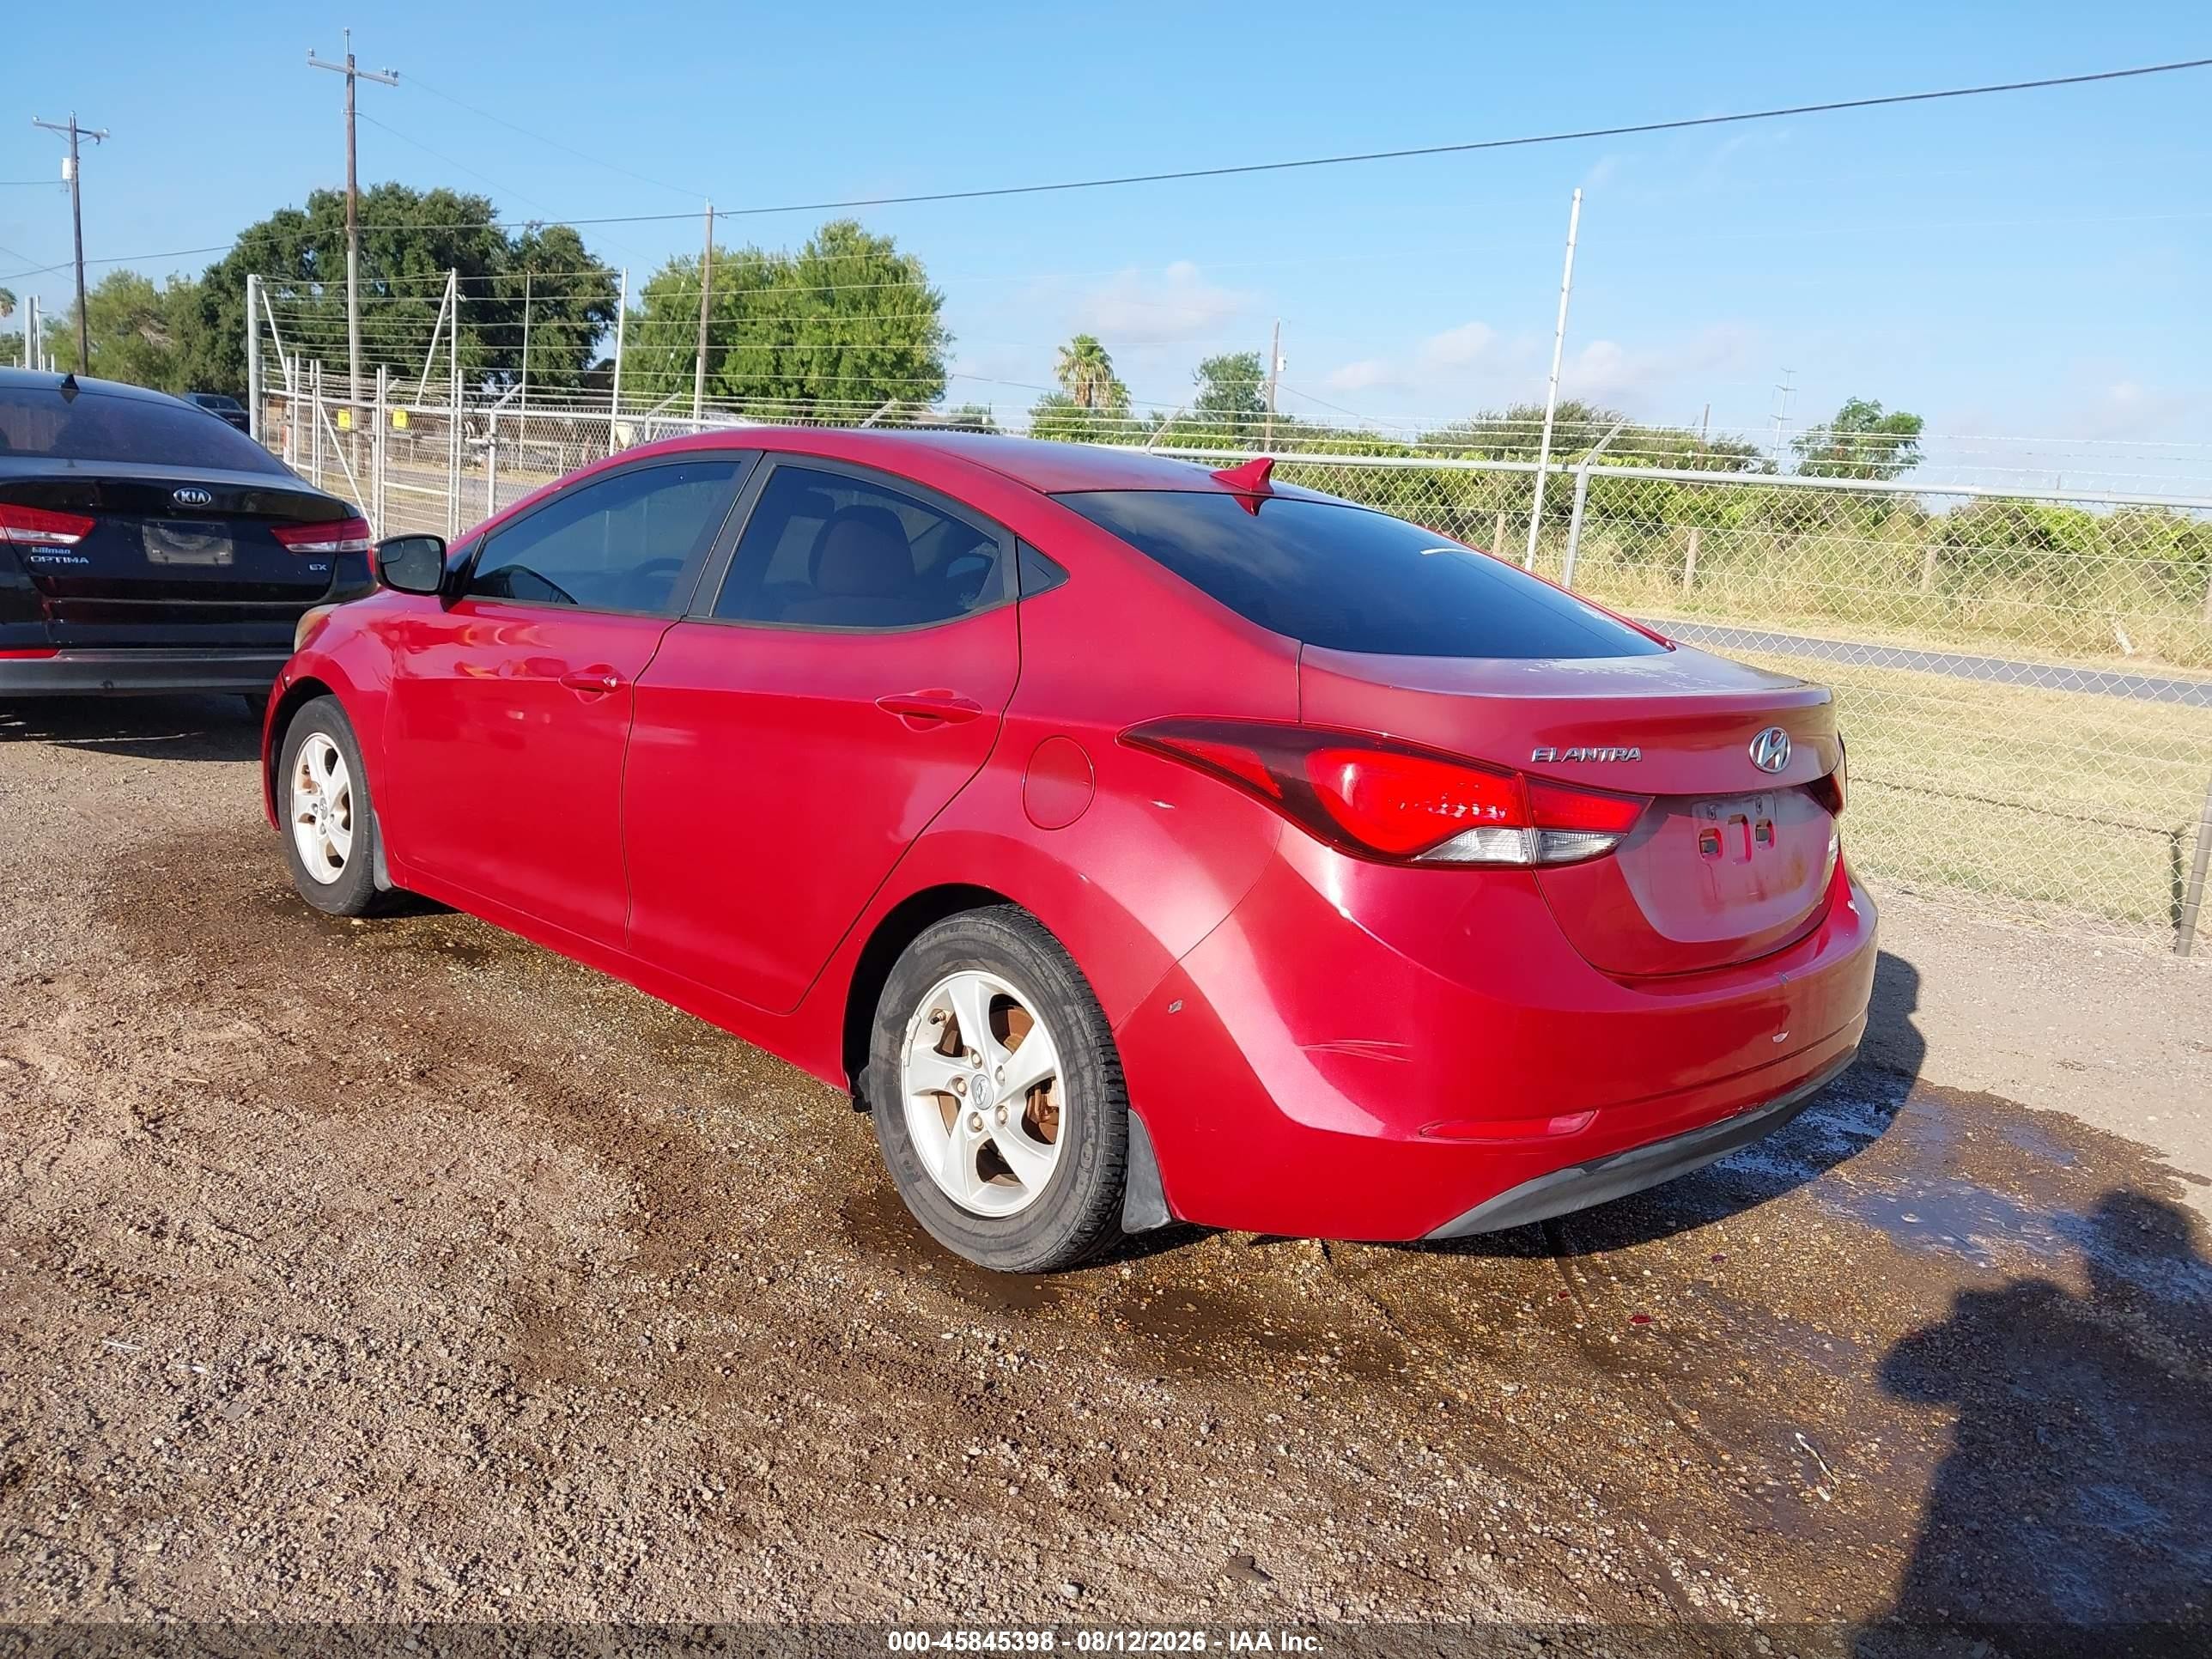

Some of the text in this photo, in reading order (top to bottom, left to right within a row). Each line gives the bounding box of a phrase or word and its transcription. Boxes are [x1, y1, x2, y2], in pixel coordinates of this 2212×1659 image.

[180, 490, 206, 502] KIA
[30, 556, 89, 564] OPTIMA
[1531, 746, 1643, 763] ELANTRA
